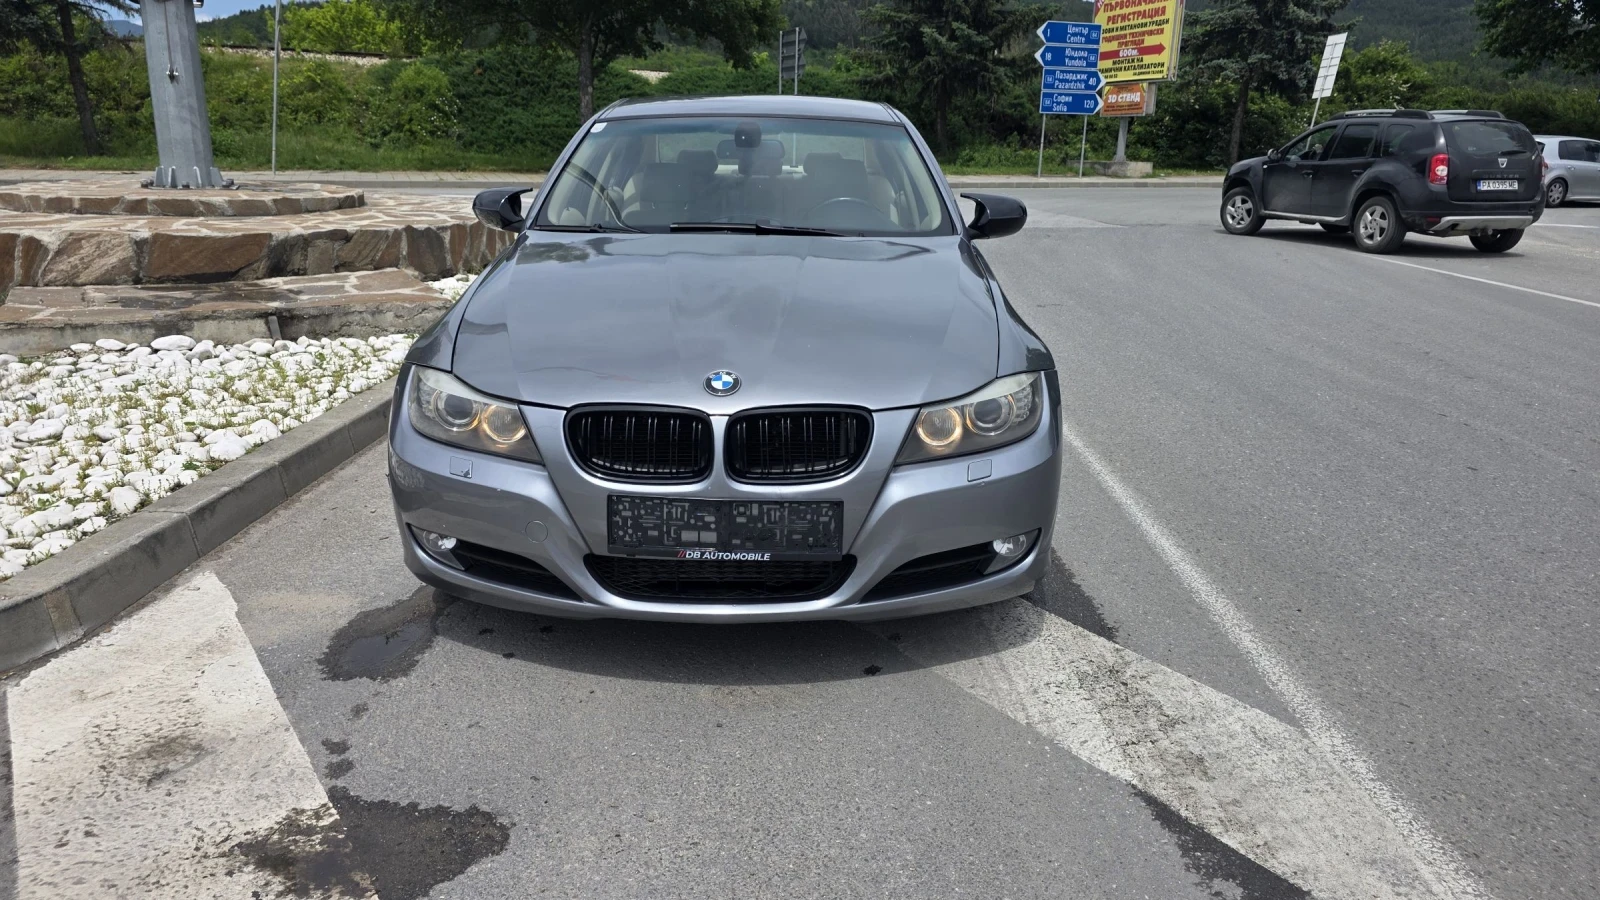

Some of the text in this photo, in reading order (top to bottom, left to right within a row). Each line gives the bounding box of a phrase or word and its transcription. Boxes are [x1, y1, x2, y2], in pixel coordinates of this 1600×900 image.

[1106, 6, 1167, 25] РЕГИСТРАЦИЯ
[1067, 25, 1089, 36] Център
[1102, 27, 1115, 35] ЗОВИ
[1119, 22, 1148, 32] МЕТАНОВИ
[1148, 18, 1170, 27] УРЕДБИ
[1047, 28, 1050, 37] 1
[1066, 35, 1086, 43] Centre
[1045, 52, 1052, 61] 18
[1065, 47, 1088, 57] Юндола
[1064, 57, 1087, 66] Yundola
[1112, 57, 1136, 65] МОНТАЖ
[1123, 62, 1165, 72] КАТАЛИЗАТОРИ
[1055, 70, 1088, 81] Пазарджик
[1054, 80, 1085, 89] Pazardzhik
[1088, 77, 1097, 86] 40
[1053, 93, 1073, 103] София
[1107, 91, 1141, 103] 3D СТЕНД
[1052, 103, 1068, 112] Sofia
[1084, 99, 1095, 108] 120
[702, 551, 771, 561] AUTOMOBILE
